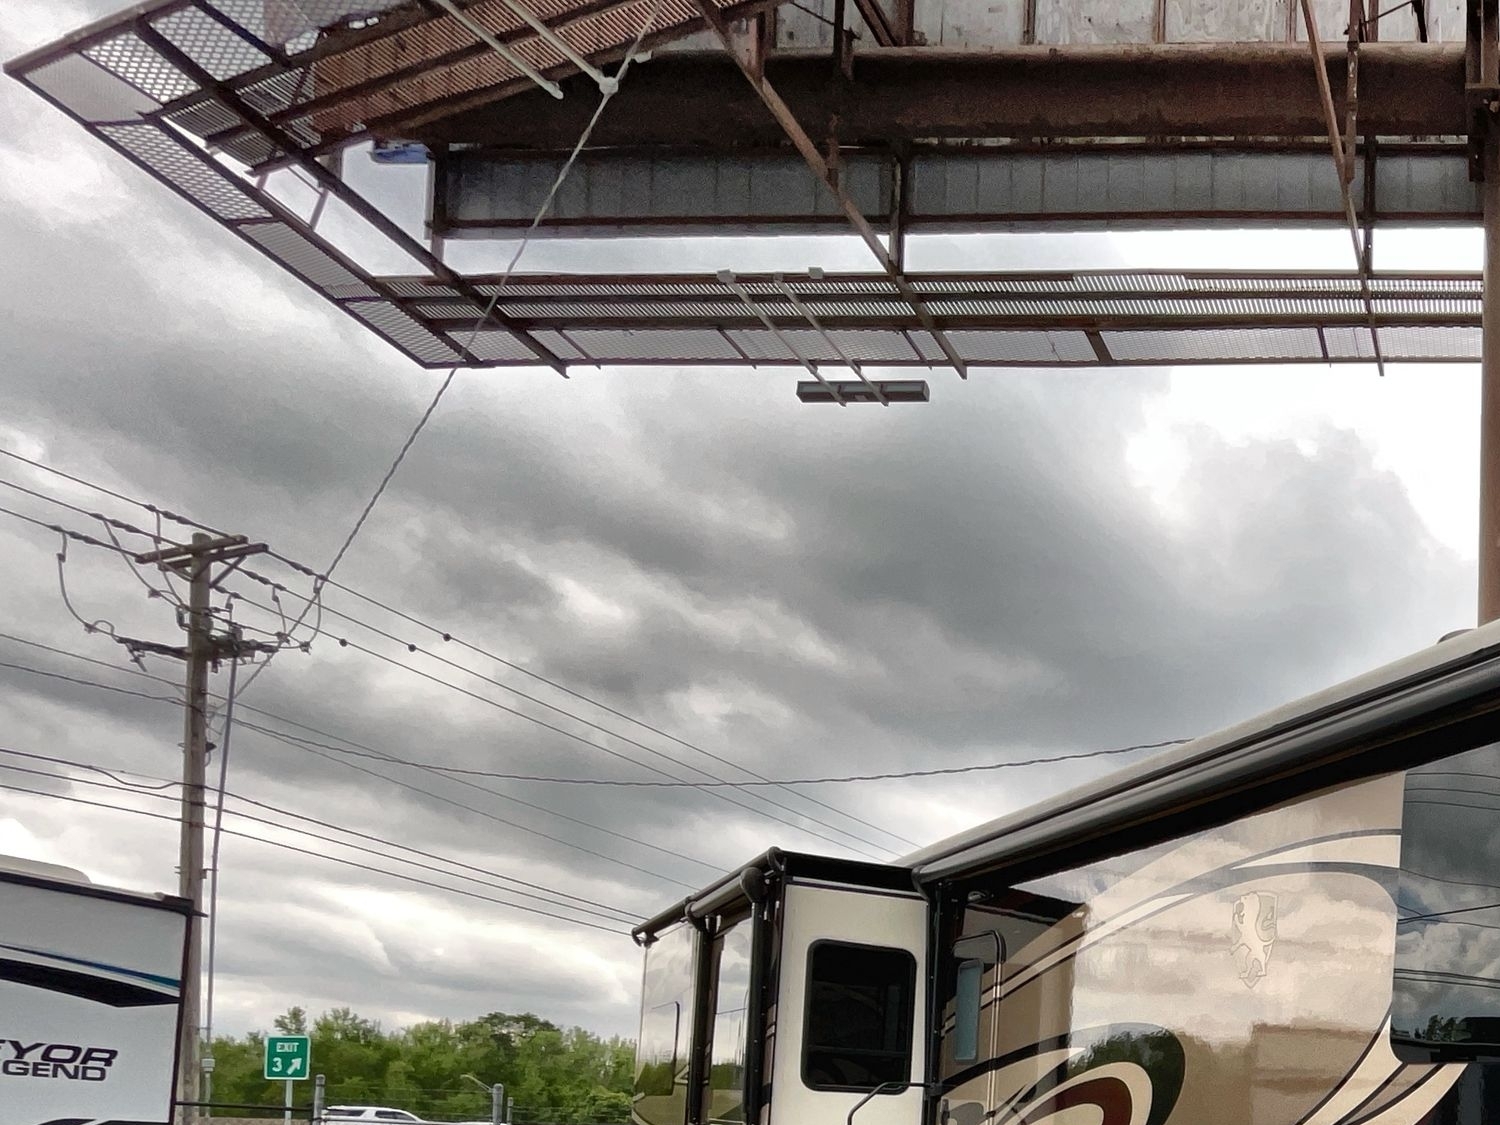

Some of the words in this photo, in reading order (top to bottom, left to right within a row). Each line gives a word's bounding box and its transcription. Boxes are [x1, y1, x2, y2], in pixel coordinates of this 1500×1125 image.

[0, 1039, 118, 1067] YOR
[276, 1042, 299, 1053] EXIT
[2, 1060, 106, 1081] GEND
[272, 1057, 282, 1072] 3
